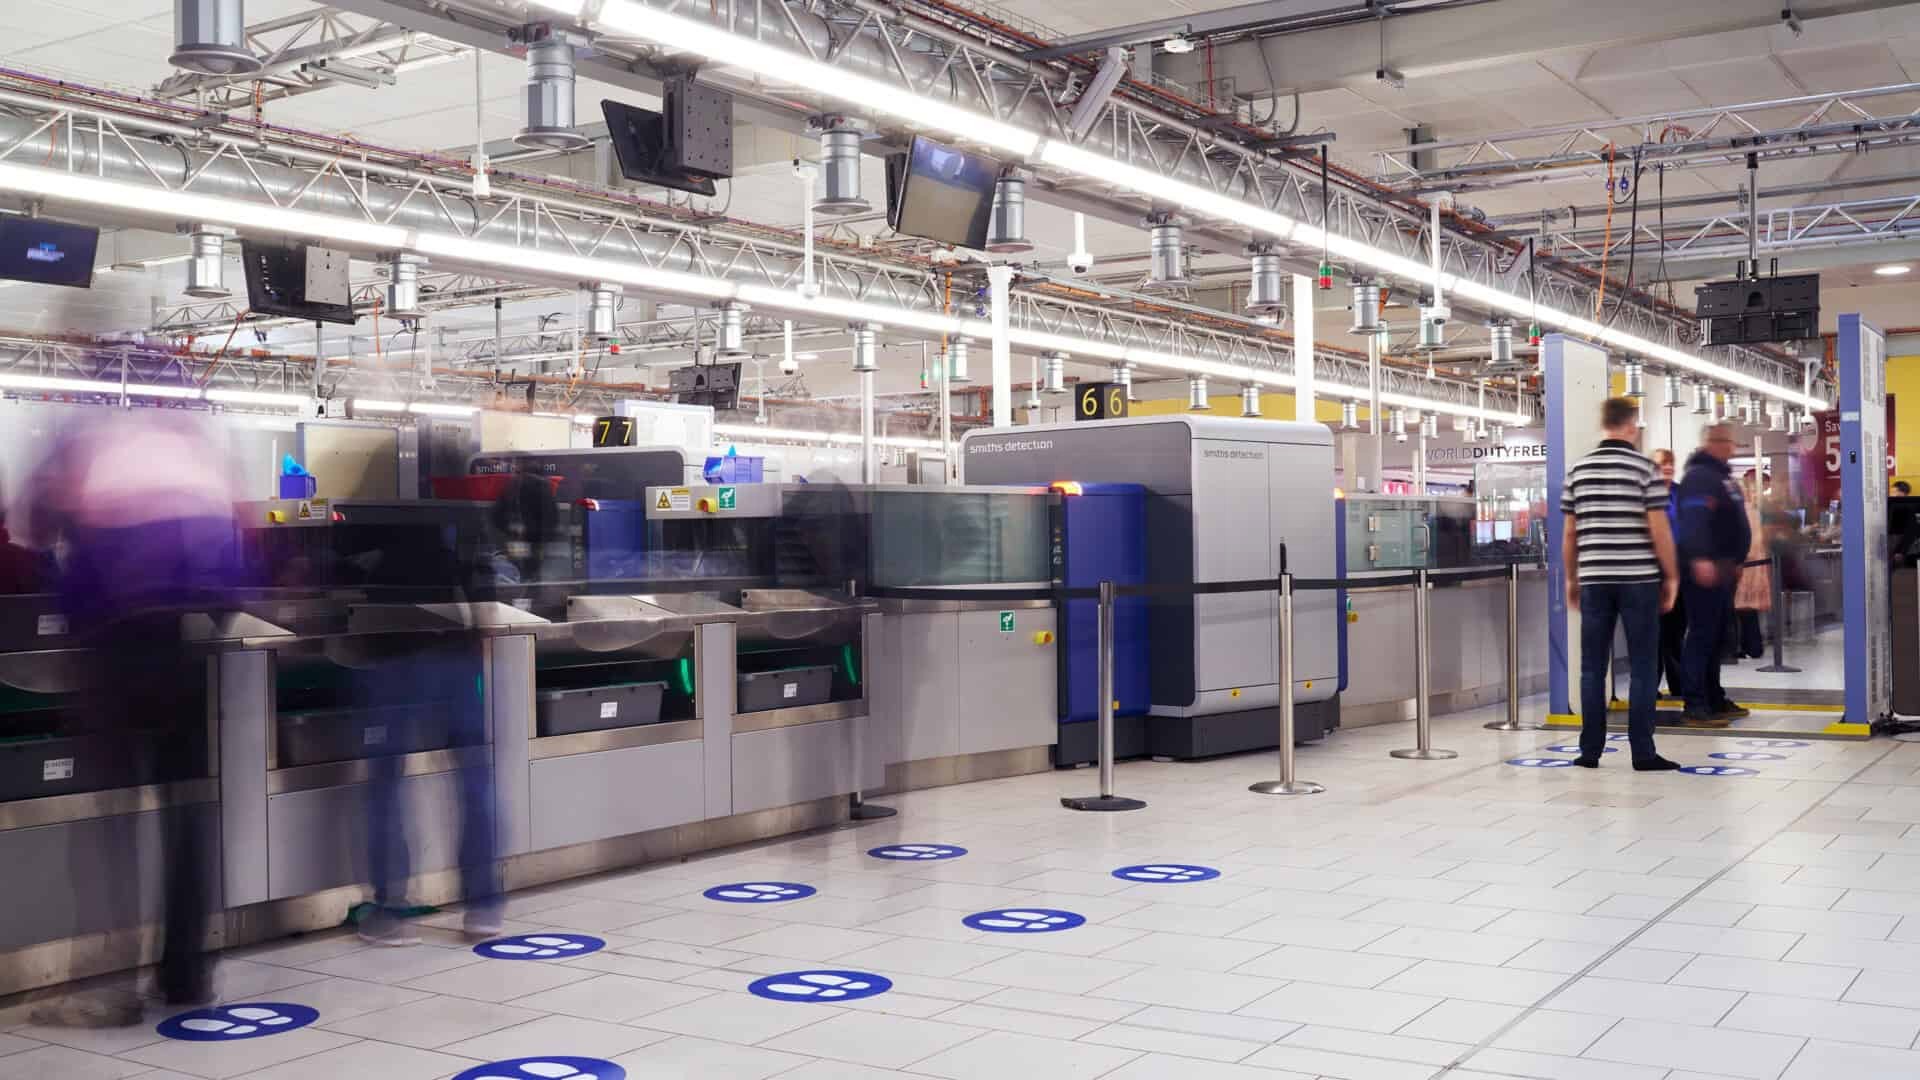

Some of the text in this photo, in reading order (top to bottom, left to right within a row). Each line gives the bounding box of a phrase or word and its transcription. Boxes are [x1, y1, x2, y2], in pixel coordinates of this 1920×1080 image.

[1082, 387, 1097, 416] 6
[1110, 388, 1122, 416] 6
[599, 420, 611, 444] 7
[622, 421, 633, 444] 7
[969, 439, 1054, 454] smiths detection
